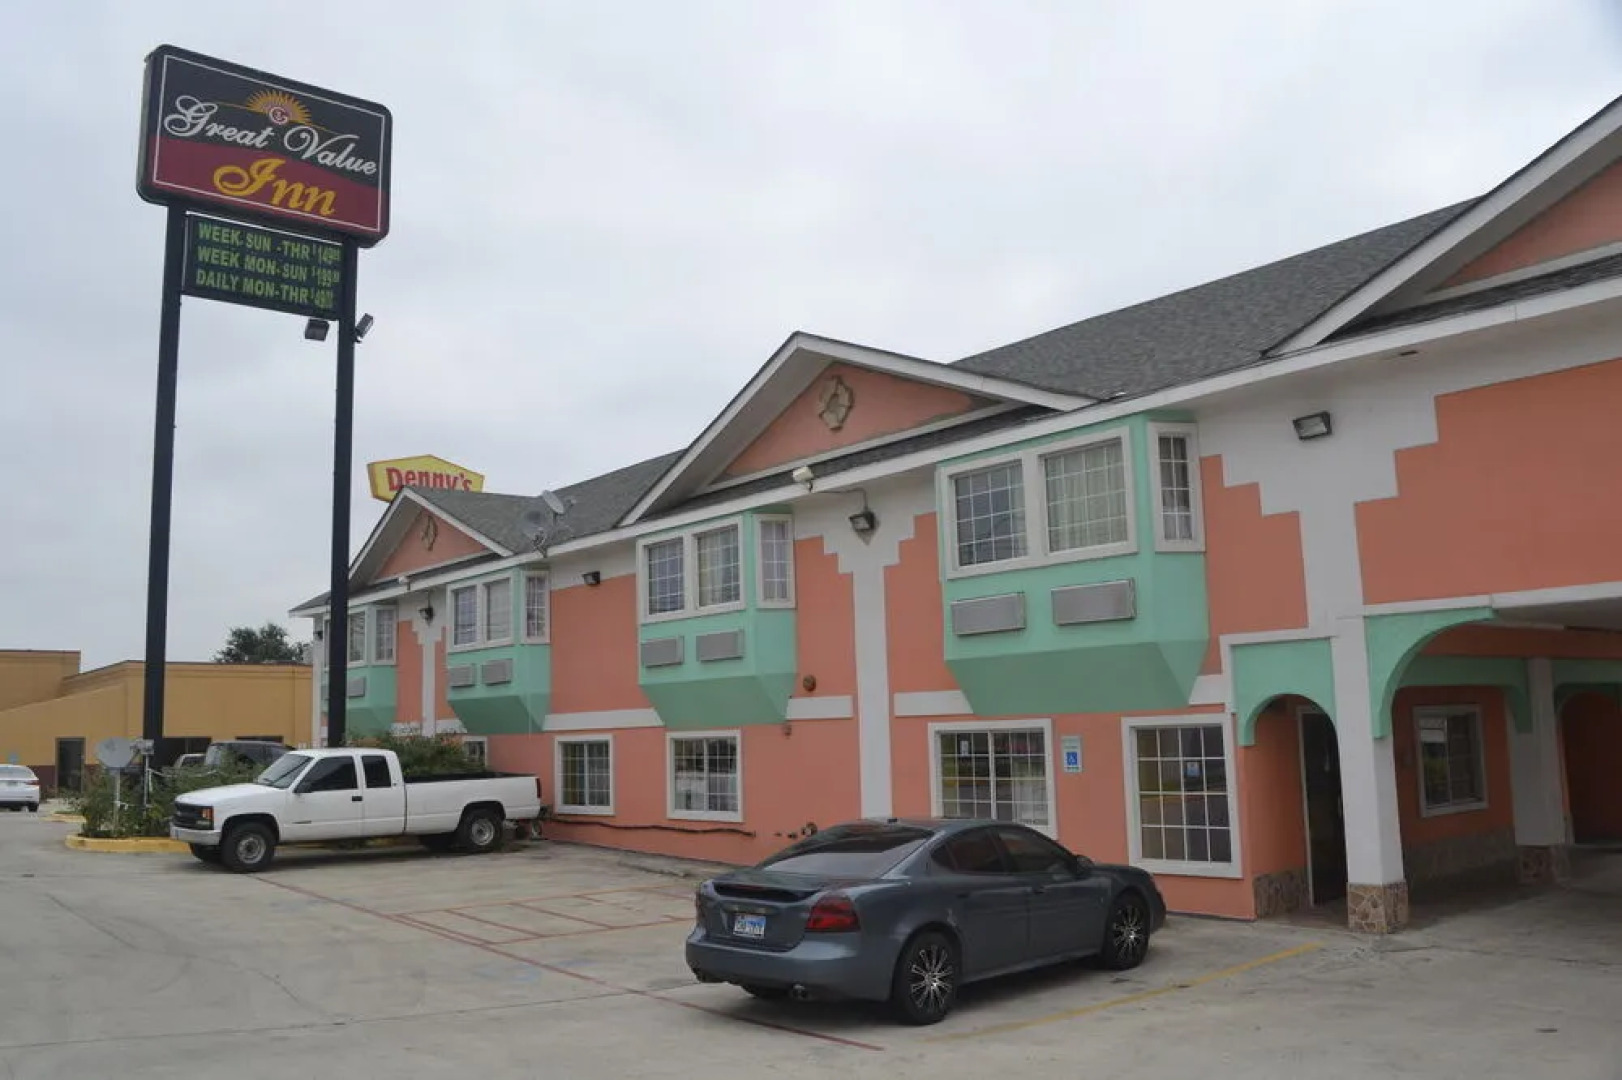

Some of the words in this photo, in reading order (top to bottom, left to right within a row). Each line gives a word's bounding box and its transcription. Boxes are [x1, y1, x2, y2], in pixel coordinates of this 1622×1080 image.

[164, 95, 275, 149] Great
[284, 126, 377, 175] Value
[213, 158, 336, 218] Inn
[246, 232, 272, 253] SUN
[197, 245, 240, 269] WEEK
[195, 269, 239, 291] DAILY
[385, 466, 473, 493] Denny's
